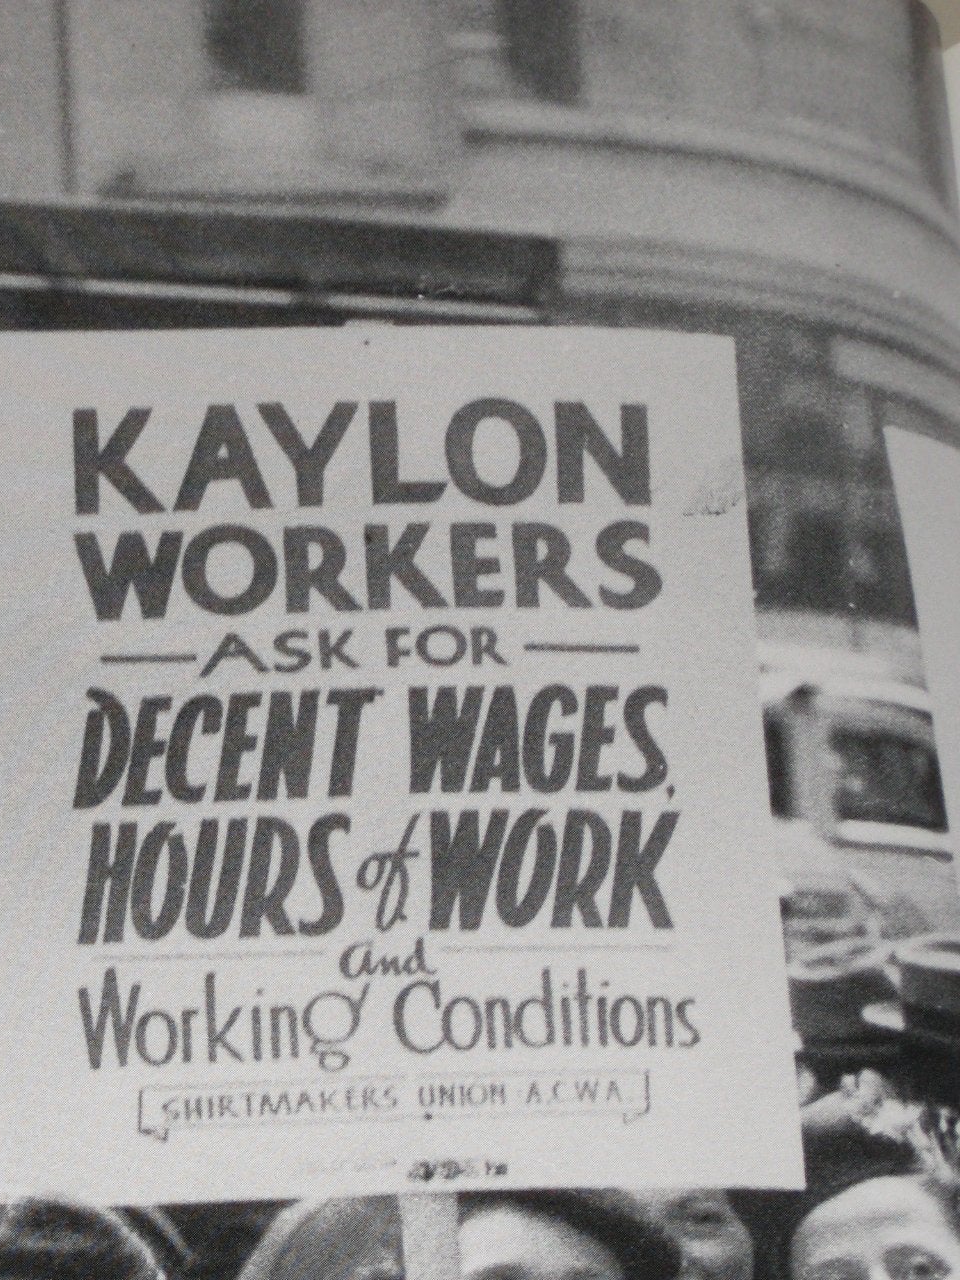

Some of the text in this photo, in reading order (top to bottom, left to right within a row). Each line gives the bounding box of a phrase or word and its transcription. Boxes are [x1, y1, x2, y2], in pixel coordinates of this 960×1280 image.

[71, 397, 653, 515] KAYLON
[73, 520, 664, 622] WORKERS
[200, 624, 509, 678] ASK FOR
[72, 684, 676, 810] DECENT WAGES,
[77, 808, 682, 946] HOURS of WORK
[339, 936, 438, 981] and
[77, 965, 702, 1073] Working Conditions
[161, 1083, 399, 1124] SHIRTMAKERS
[417, 1081, 506, 1108] UNION
